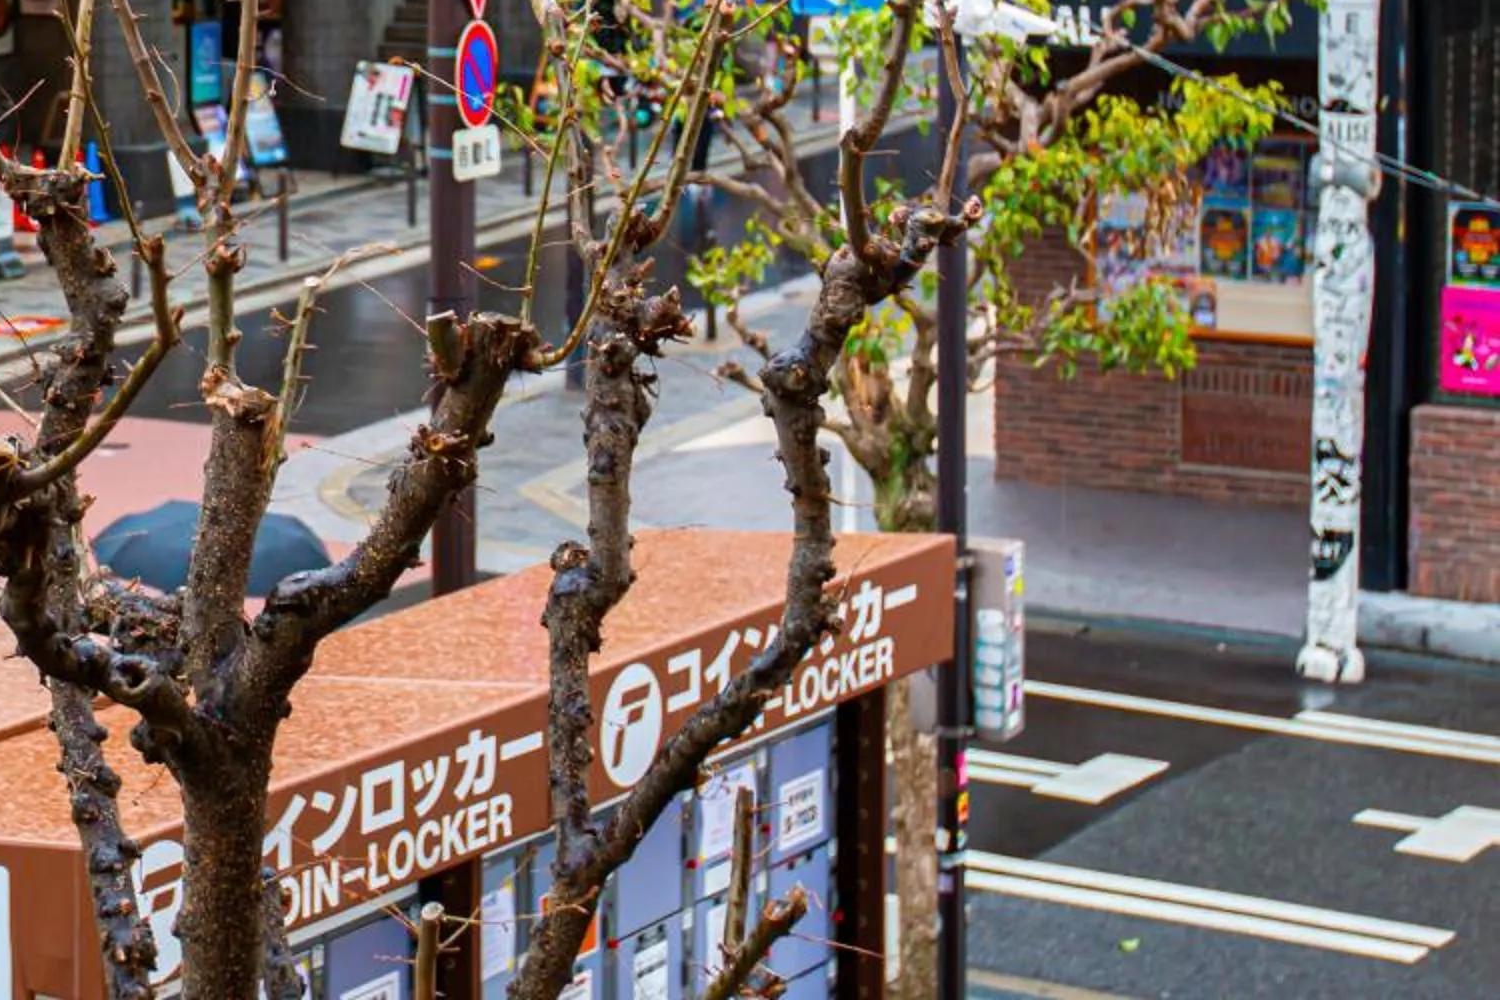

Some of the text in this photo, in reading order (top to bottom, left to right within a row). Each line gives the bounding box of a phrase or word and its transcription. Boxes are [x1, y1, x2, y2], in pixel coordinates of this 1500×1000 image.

[667, 579, 917, 712] コインカー
[263, 729, 545, 870] インロッカー
[283, 793, 513, 929] OIN-LOCKER
